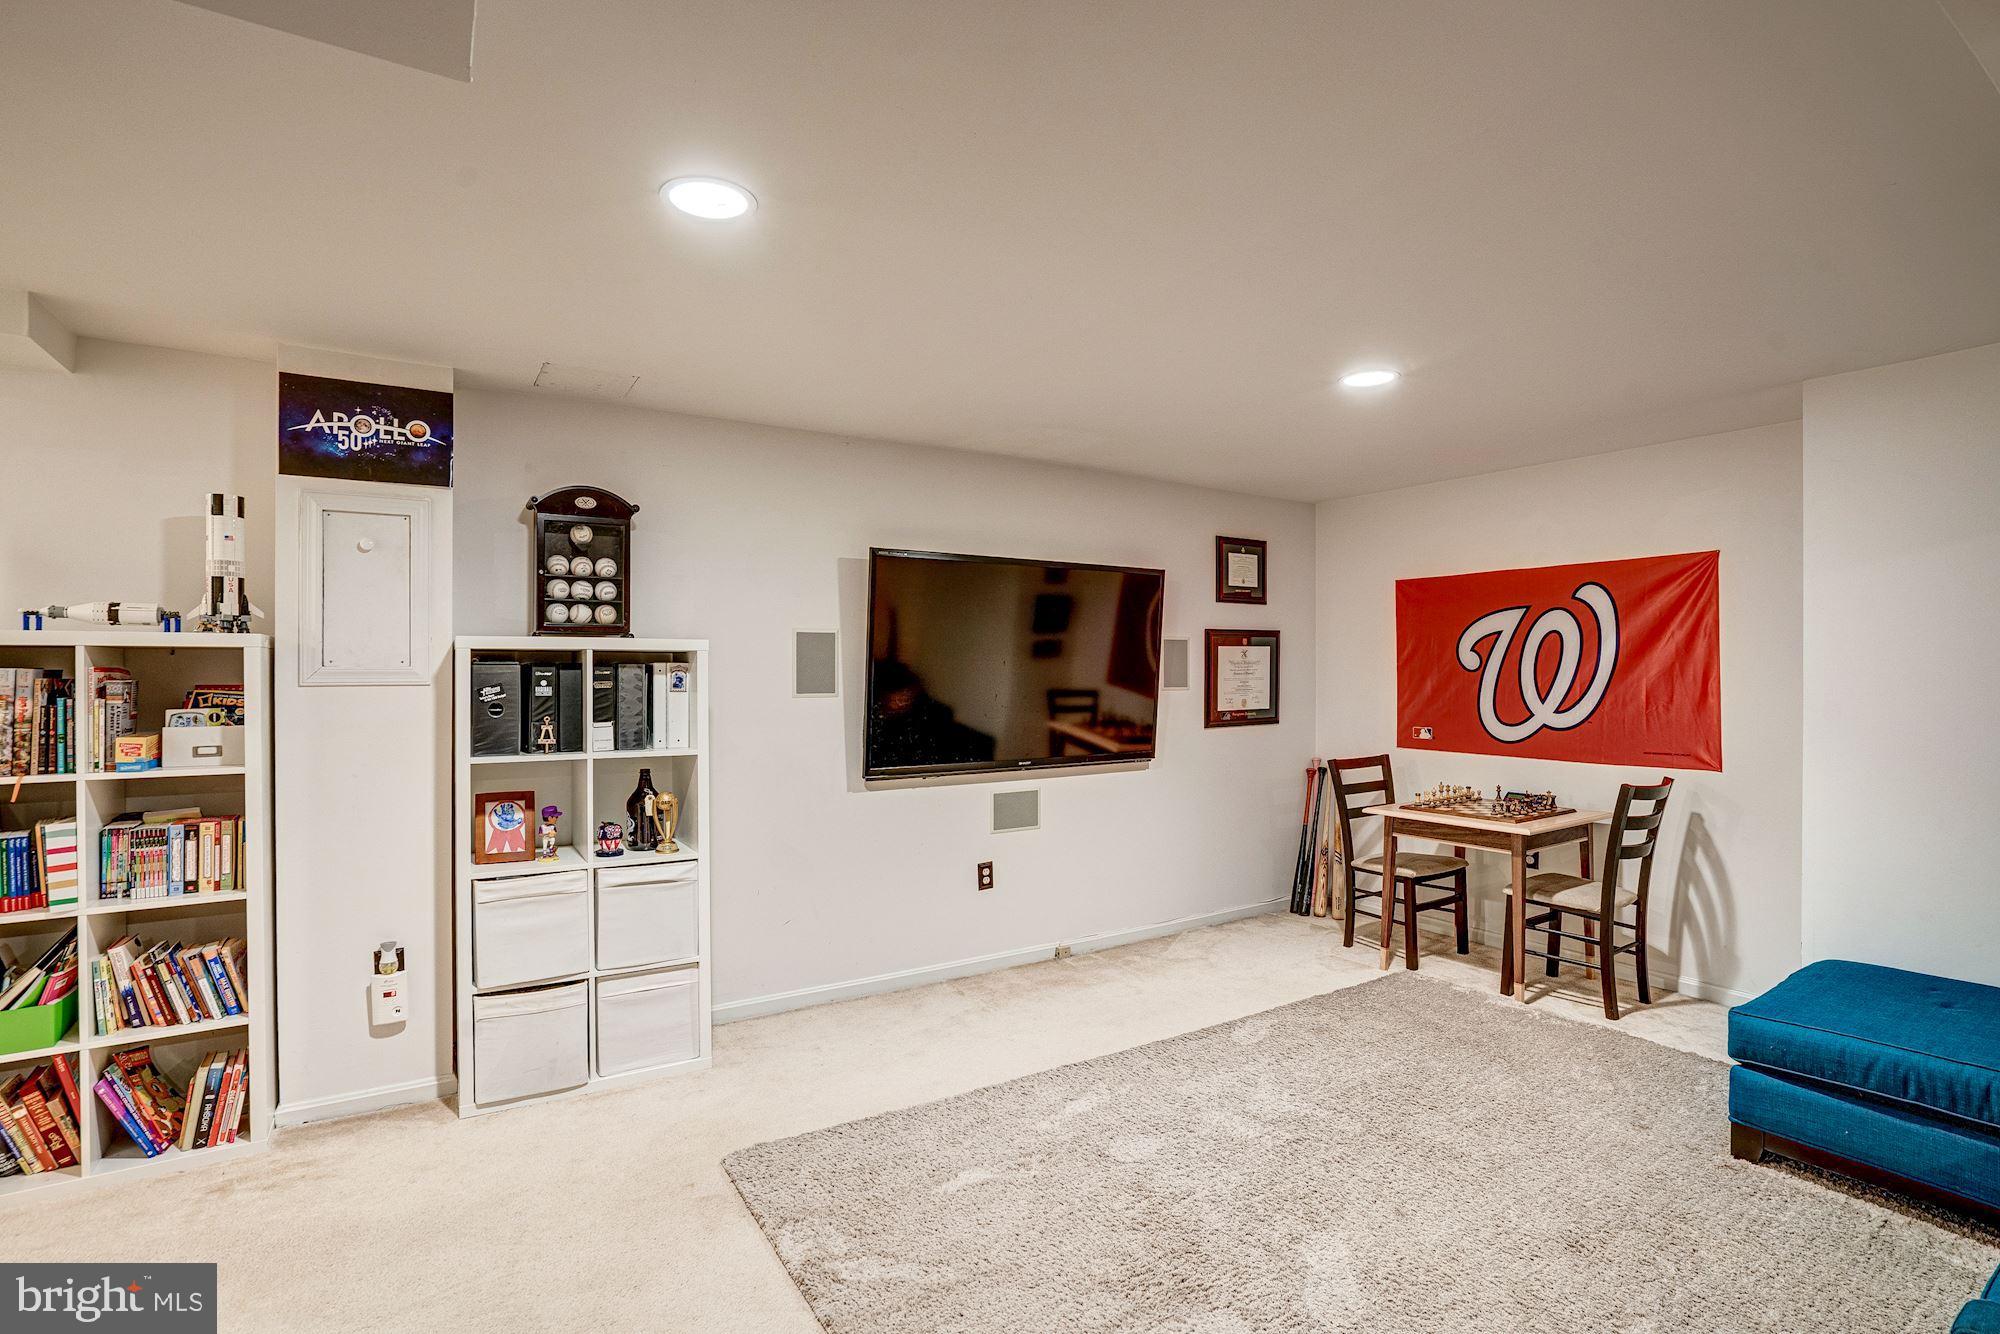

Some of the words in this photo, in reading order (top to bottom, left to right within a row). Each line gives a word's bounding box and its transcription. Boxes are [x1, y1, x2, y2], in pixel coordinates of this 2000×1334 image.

[305, 408, 431, 442] APOLLO
[338, 430, 362, 452] 50
[1456, 581, 1620, 743] W
[212, 697, 244, 707] KIDS
[200, 1103, 212, 1132] AHSOKA
